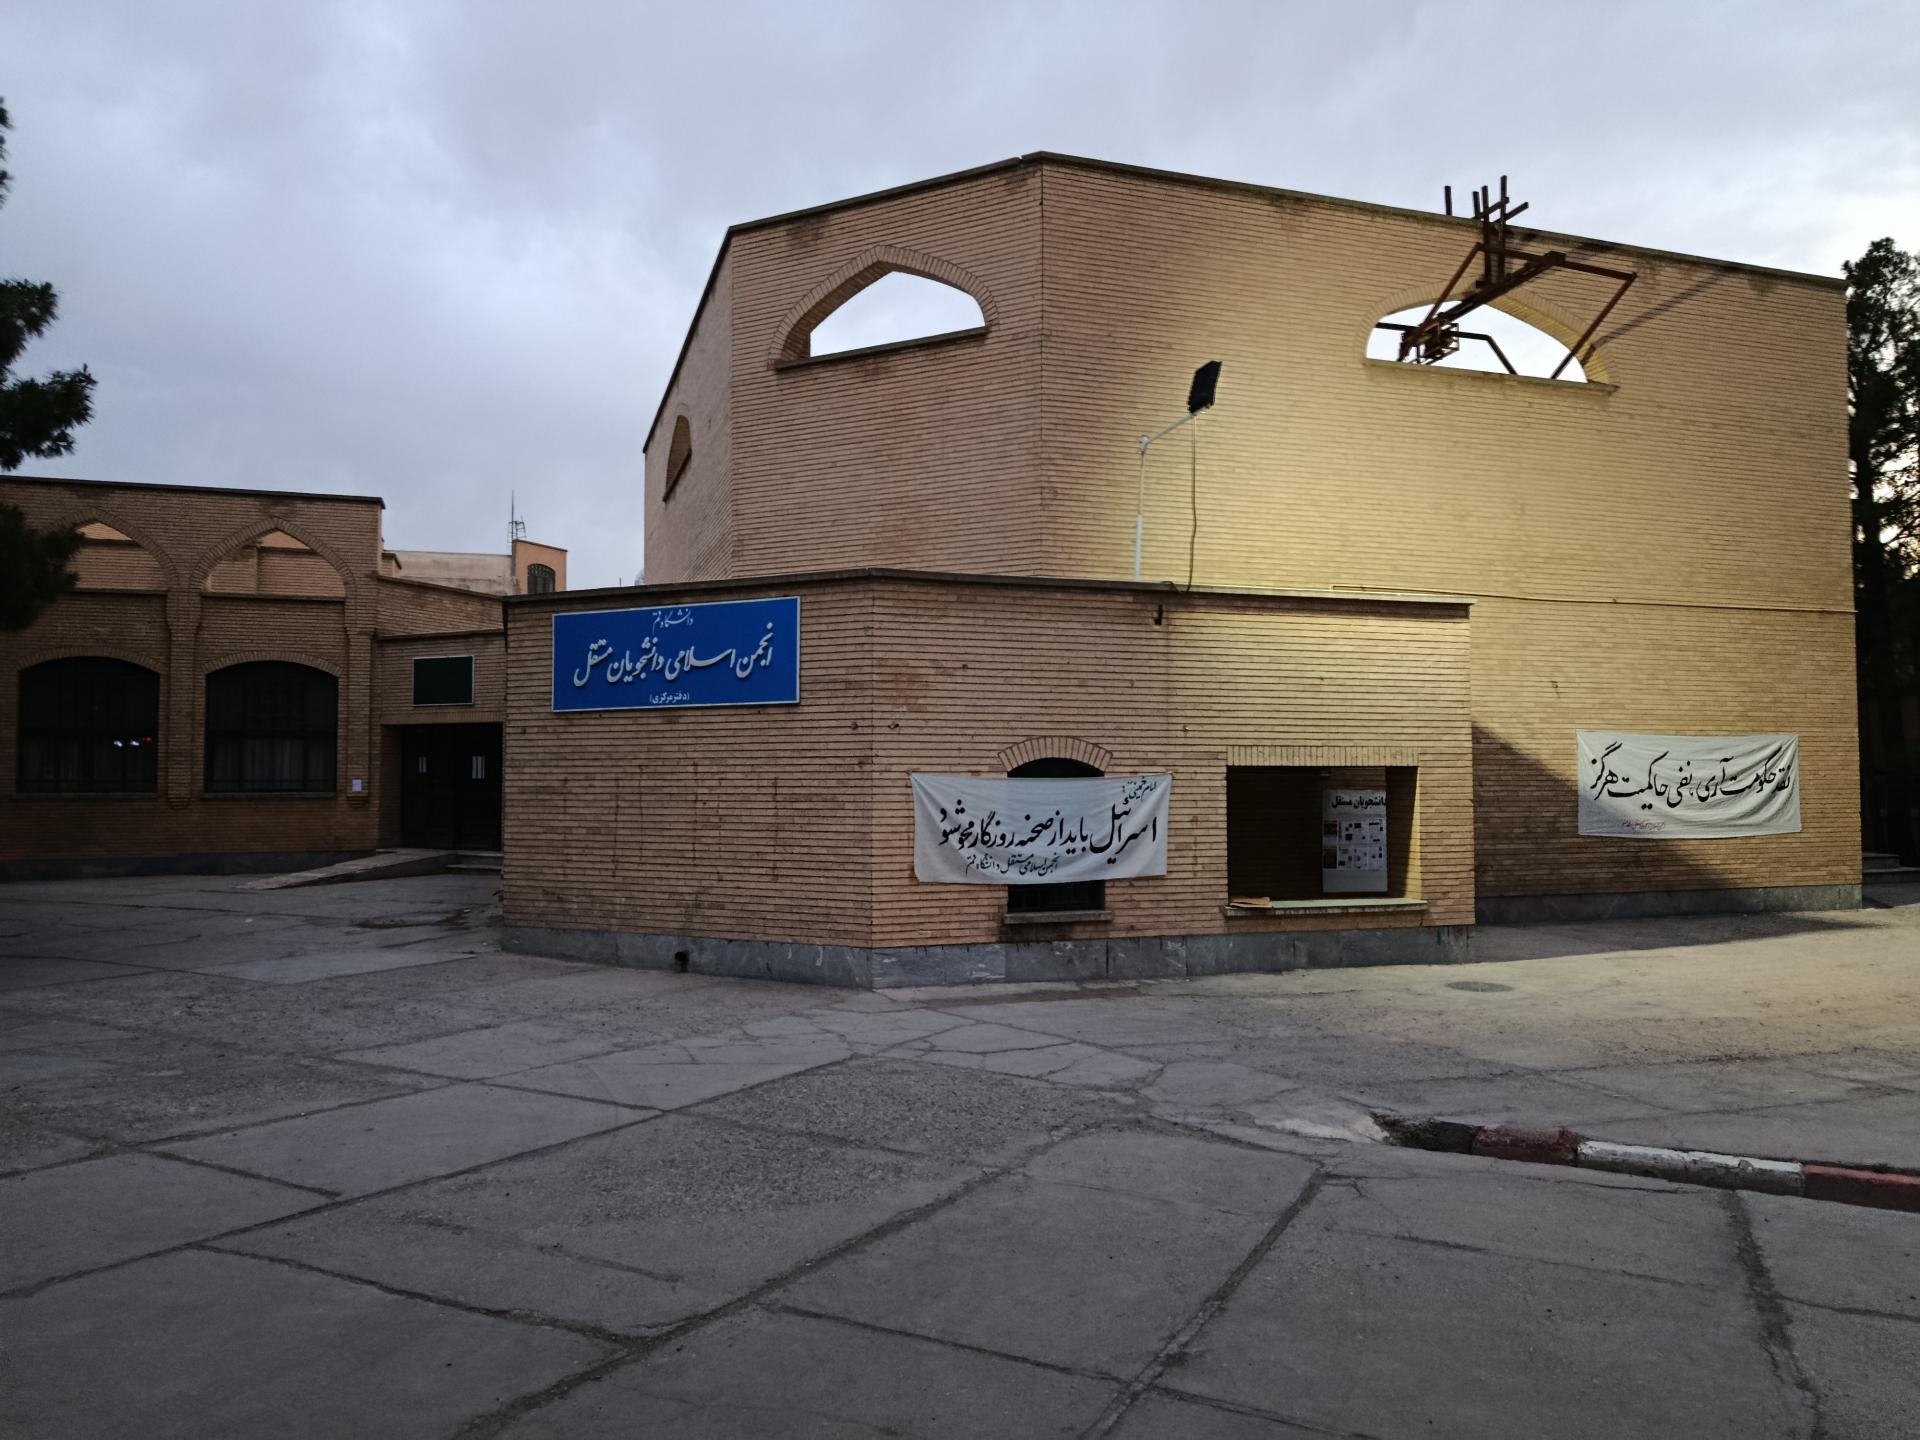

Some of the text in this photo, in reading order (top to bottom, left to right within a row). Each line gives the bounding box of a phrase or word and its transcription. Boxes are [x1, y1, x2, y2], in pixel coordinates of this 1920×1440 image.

[652, 608, 693, 635] دانشگاه قم
[573, 622, 773, 687] انجمن اسلامی دانشجویان مستقل
[1590, 741, 1623, 801] هرگز
[1607, 750, 1670, 810] حاکمیت
[1667, 760, 1693, 808] نفی
[1721, 744, 1783, 796] حکومت
[1774, 764, 1791, 793] نقد
[938, 795, 1158, 865] اسرائیل باید از صحنه روزگار محو شود
[965, 852, 1060, 877] انجمن اسلامی مستقل دانشگاه قم
